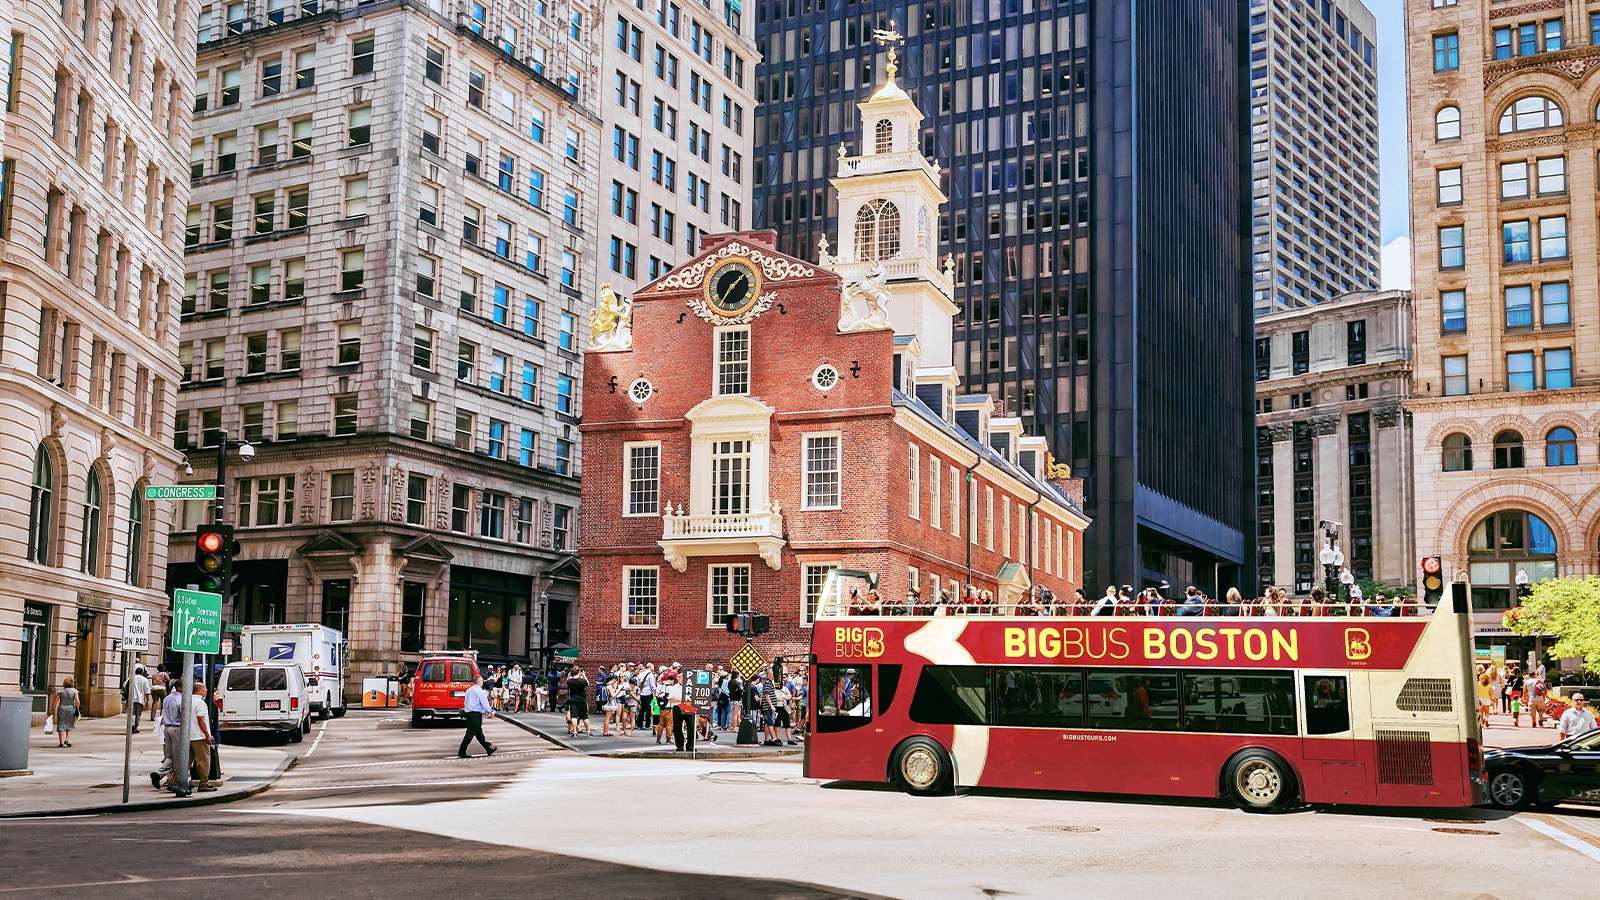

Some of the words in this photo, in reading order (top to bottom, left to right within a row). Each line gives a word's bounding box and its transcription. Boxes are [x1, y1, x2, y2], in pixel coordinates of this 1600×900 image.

[157, 487, 205, 498] CONGRESS
[182, 596, 197, 605] Station
[197, 607, 218, 617] Downtown
[132, 614, 142, 623] NO
[197, 616, 216, 628] Crossing
[129, 625, 145, 634] TURN
[835, 627, 863, 643] BIG
[124, 636, 133, 646] ON
[135, 637, 148, 646] RED
[1143, 628, 1299, 661] BOSTON
[835, 643, 863, 658] BUS
[685, 671, 693, 701] PARK
[695, 688, 710, 697] 7.00
[1062, 733, 1117, 742] BIGBUSTOURS.COM
